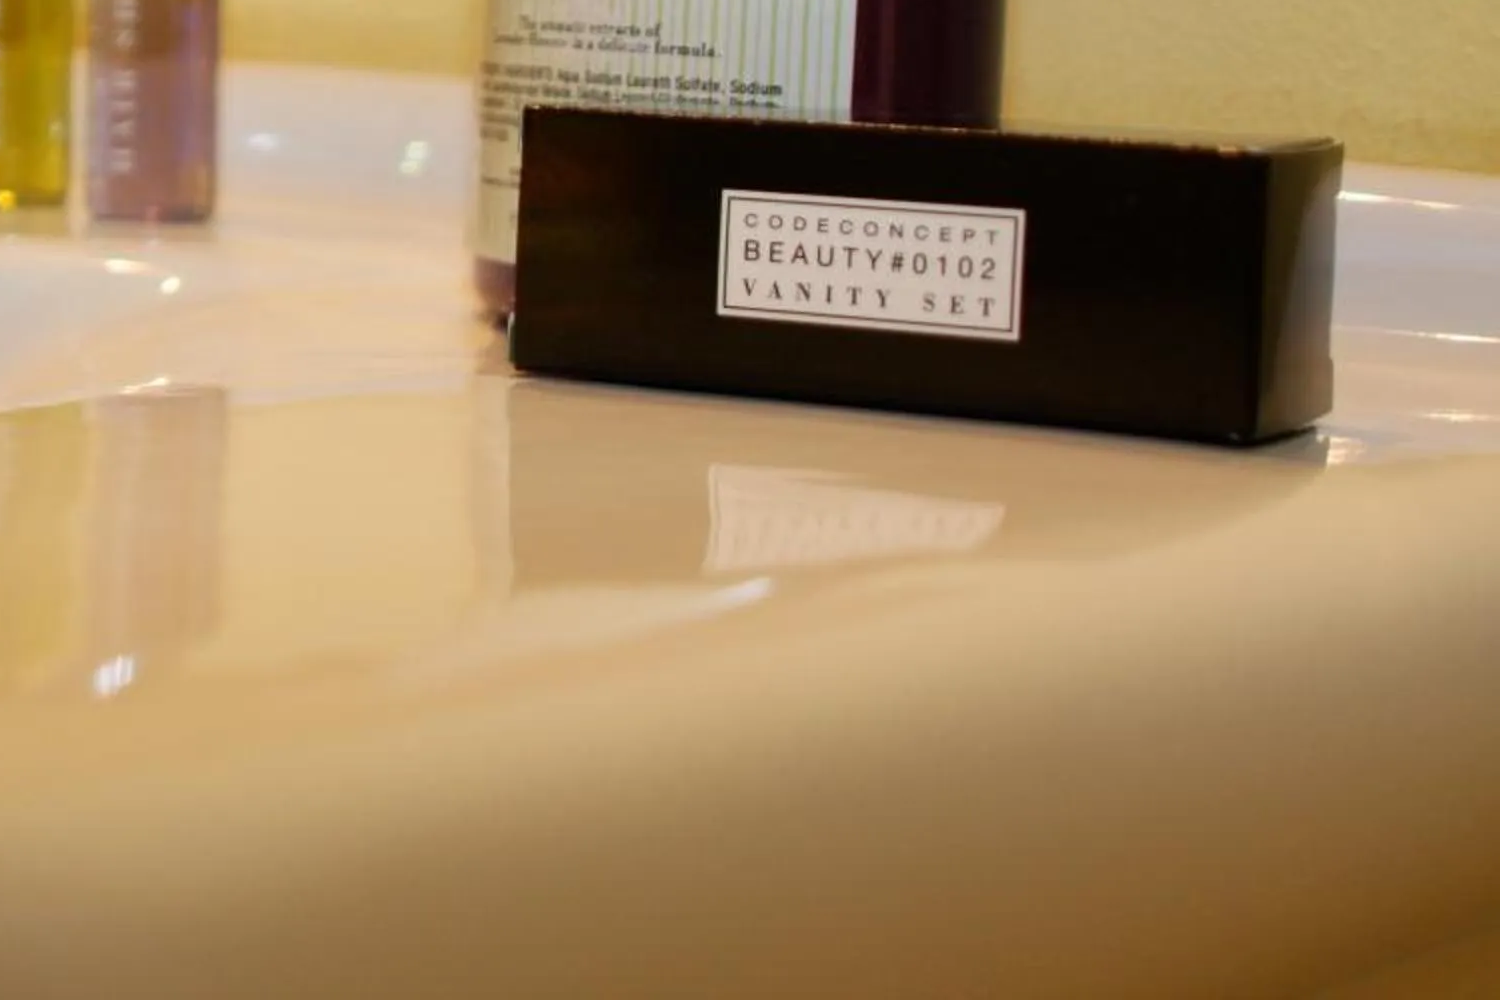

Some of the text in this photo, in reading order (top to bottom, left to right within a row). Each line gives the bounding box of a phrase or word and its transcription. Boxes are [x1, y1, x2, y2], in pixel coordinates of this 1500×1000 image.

[729, 79, 783, 96] Sodium
[743, 213, 999, 245] CODECONCEPT
[743, 239, 996, 280] BEAUTY#0102
[742, 277, 996, 317] VANITY SET
